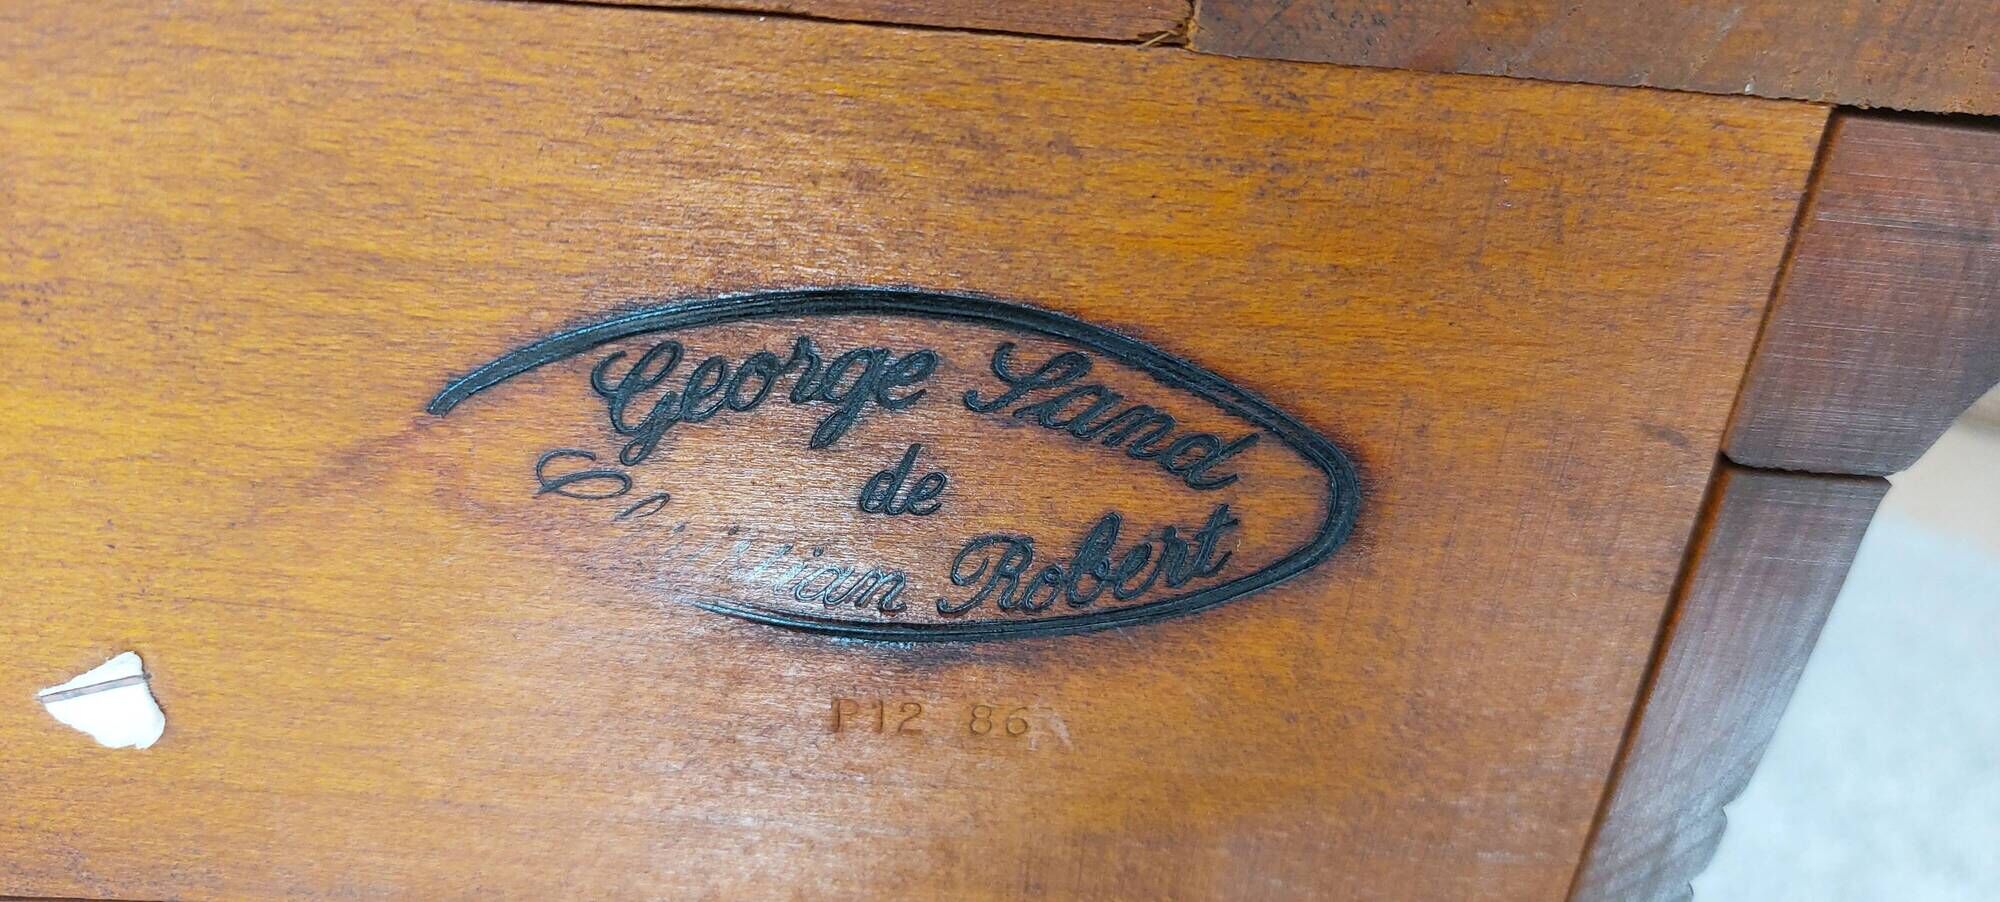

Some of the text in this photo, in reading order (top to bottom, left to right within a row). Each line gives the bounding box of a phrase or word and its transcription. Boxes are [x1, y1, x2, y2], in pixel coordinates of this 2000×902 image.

[591, 336, 1259, 490] George Sand
[858, 443, 948, 516] de
[936, 503, 1241, 614] Robert
[830, 698, 1029, 737] P12 86
